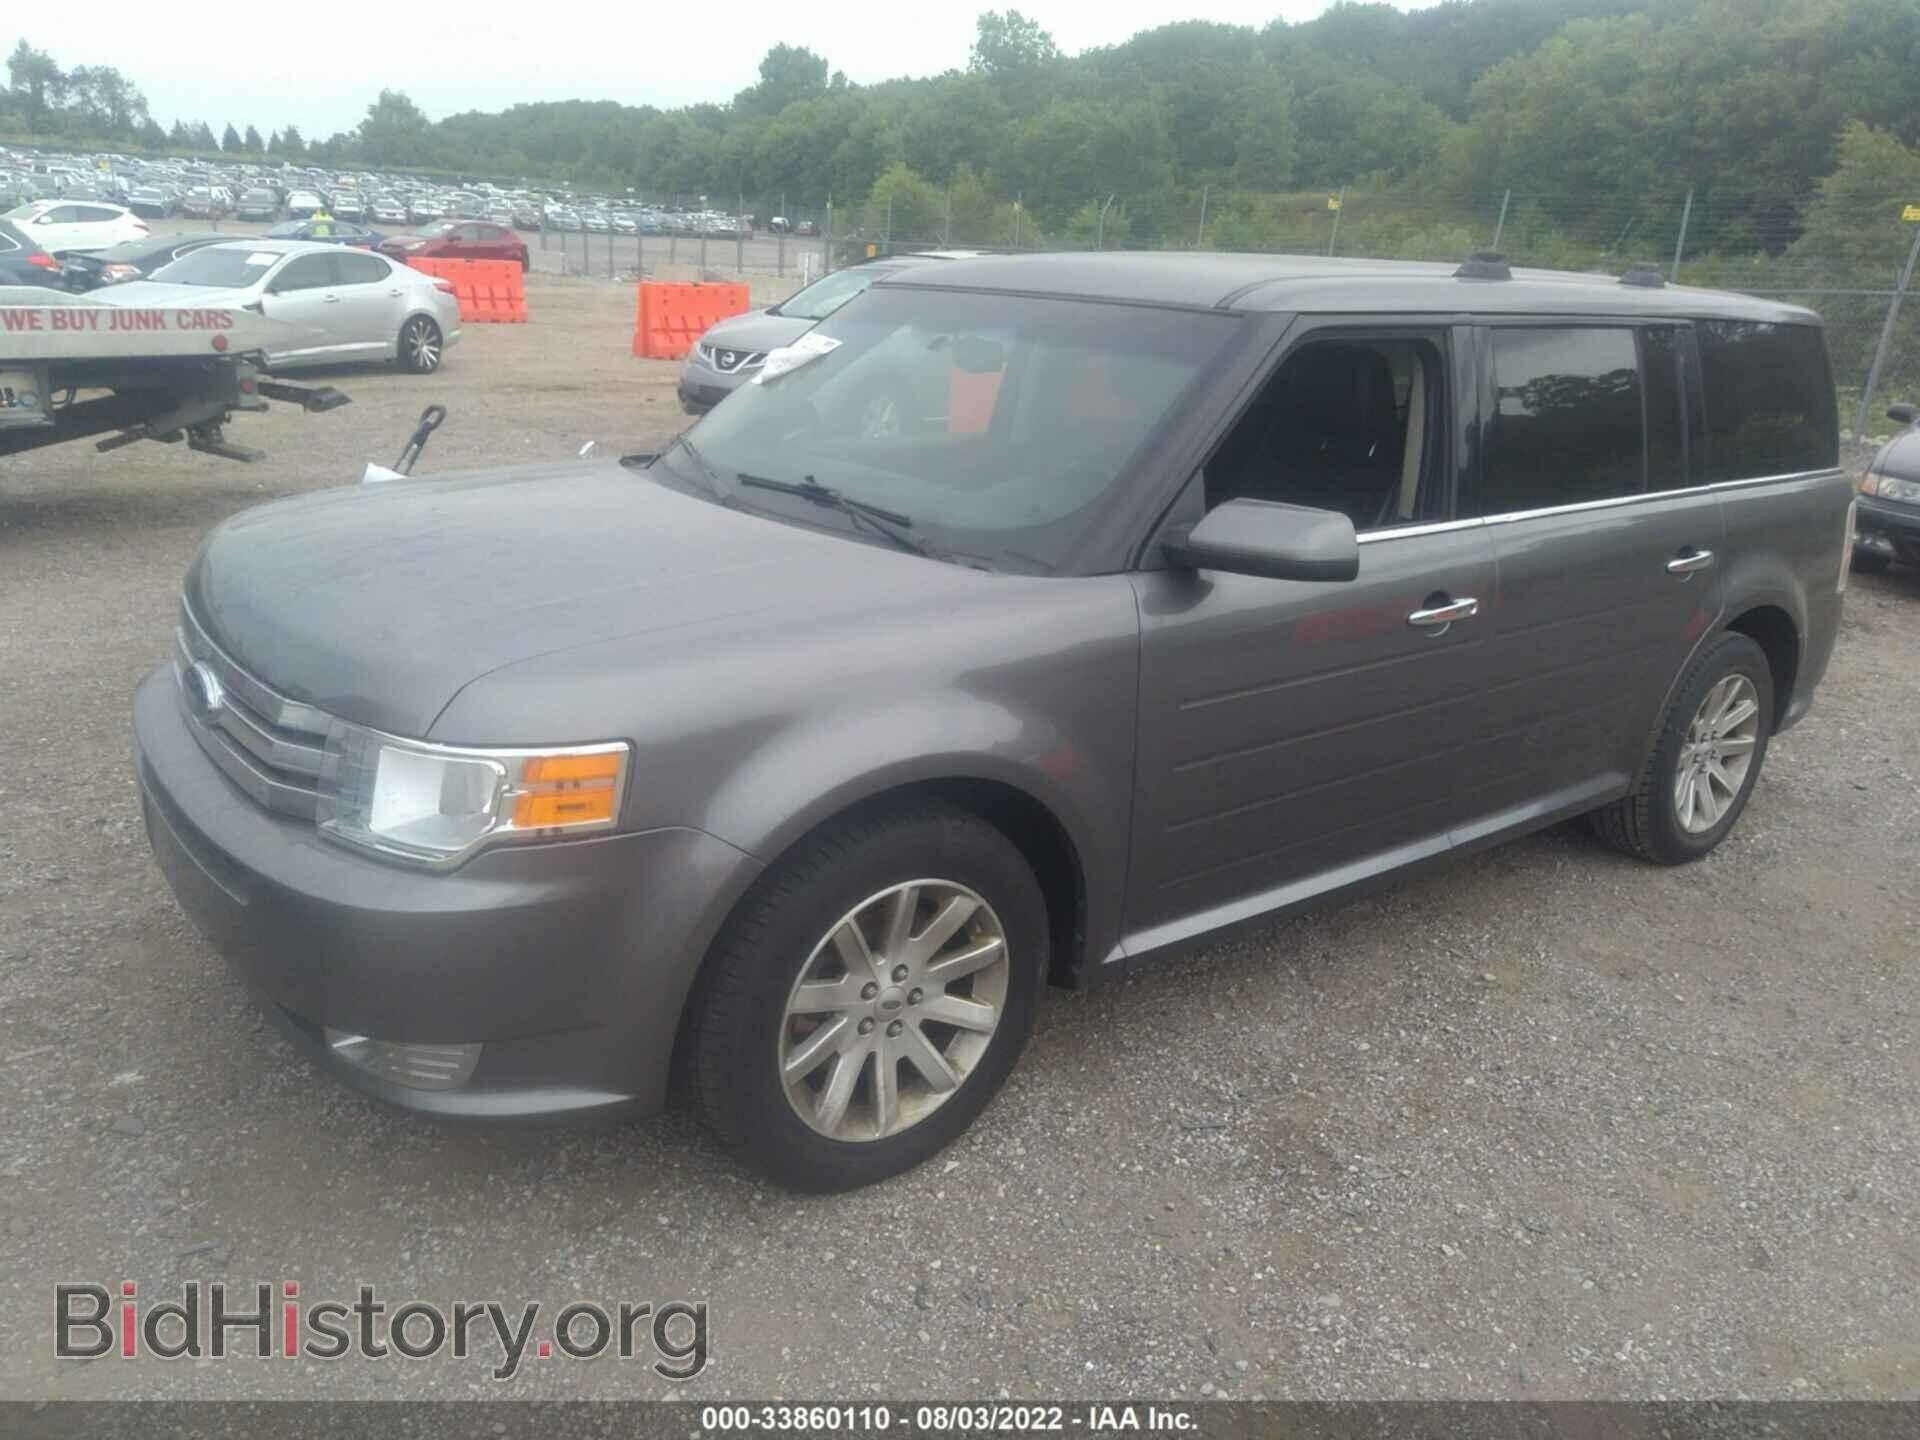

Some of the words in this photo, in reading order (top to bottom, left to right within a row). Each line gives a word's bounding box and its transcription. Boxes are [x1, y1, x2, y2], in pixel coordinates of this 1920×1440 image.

[2, 309, 43, 331] WE
[51, 309, 99, 330] BUY
[109, 309, 169, 330] JUNK
[176, 309, 234, 330] CARS
